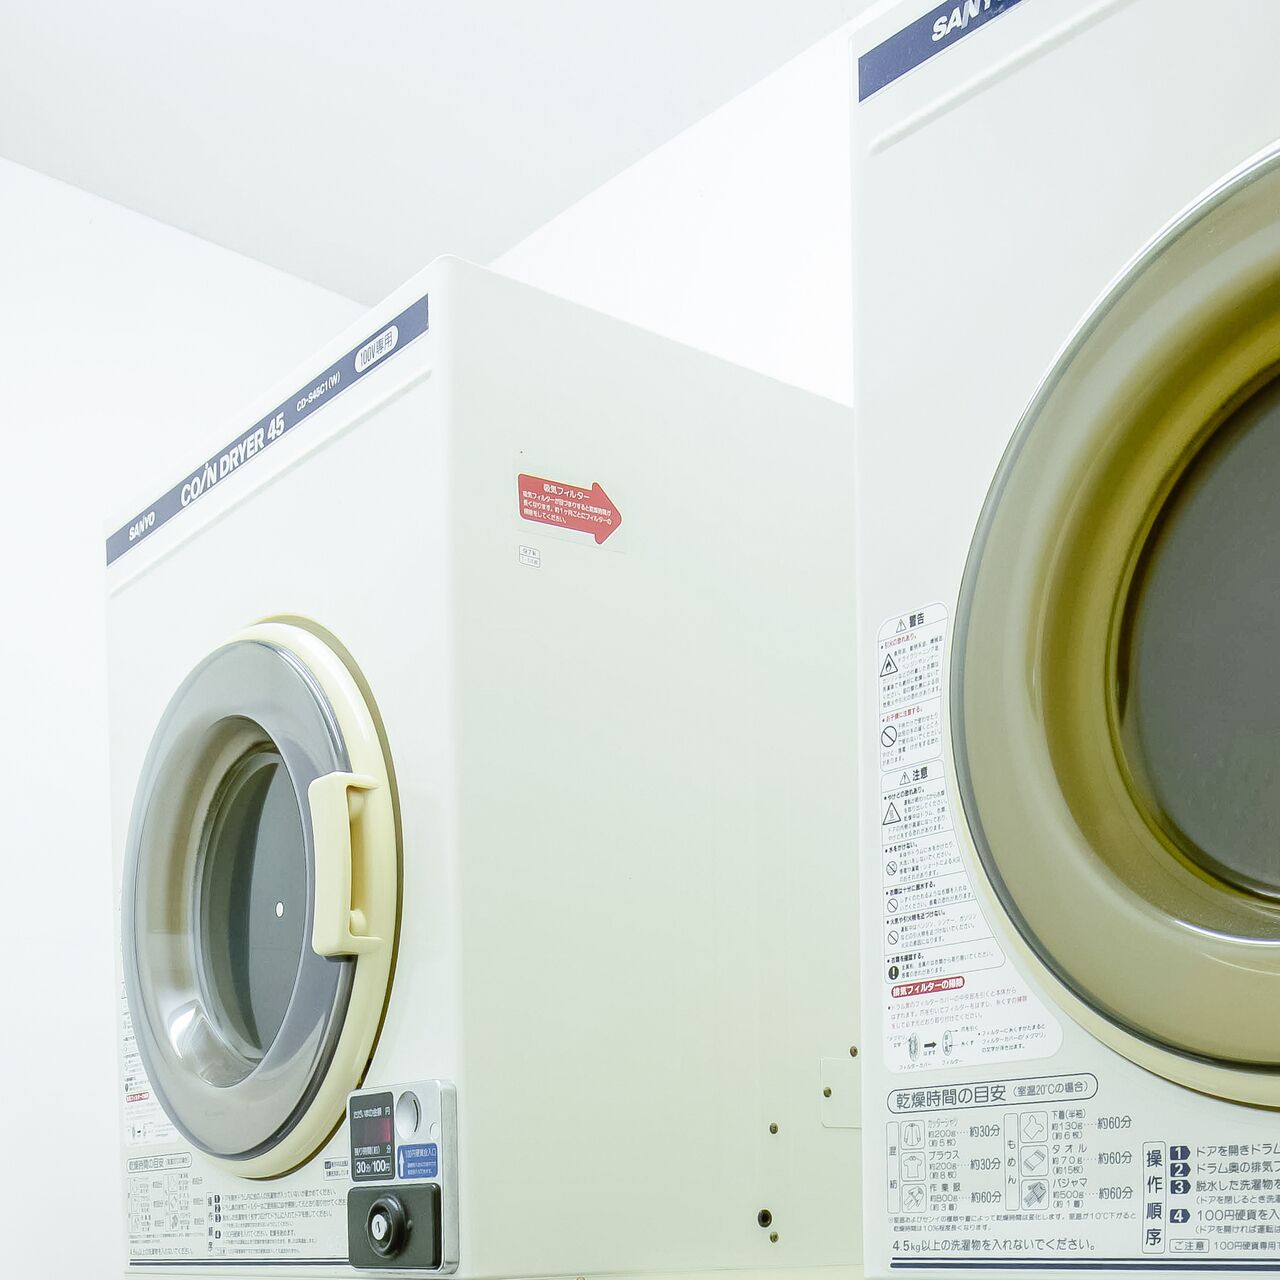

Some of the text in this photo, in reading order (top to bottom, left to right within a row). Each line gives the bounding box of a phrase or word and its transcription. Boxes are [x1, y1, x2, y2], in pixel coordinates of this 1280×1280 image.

[128, 511, 156, 541] SANYO
[220, 428, 264, 481] DRYER
[267, 412, 286, 441] 45
[912, 766, 928, 781] 注意
[896, 1084, 1007, 1110] 乾燥時間の目安
[1097, 1115, 1132, 1130] 約60分
[969, 1124, 1000, 1138] 約30分
[929, 1150, 960, 1161] ブラウス
[1098, 1150, 1133, 1165] 約60分
[970, 1157, 1001, 1171] 約30分
[1052, 1177, 1088, 1188] パジャマ
[970, 1190, 1002, 1204] 約60分
[1099, 1186, 1134, 1200] 約60分
[1146, 1149, 1163, 1247] 操作順序
[892, 1238, 1096, 1253] 4.5kg以上の洗濯物を入れないでください。
